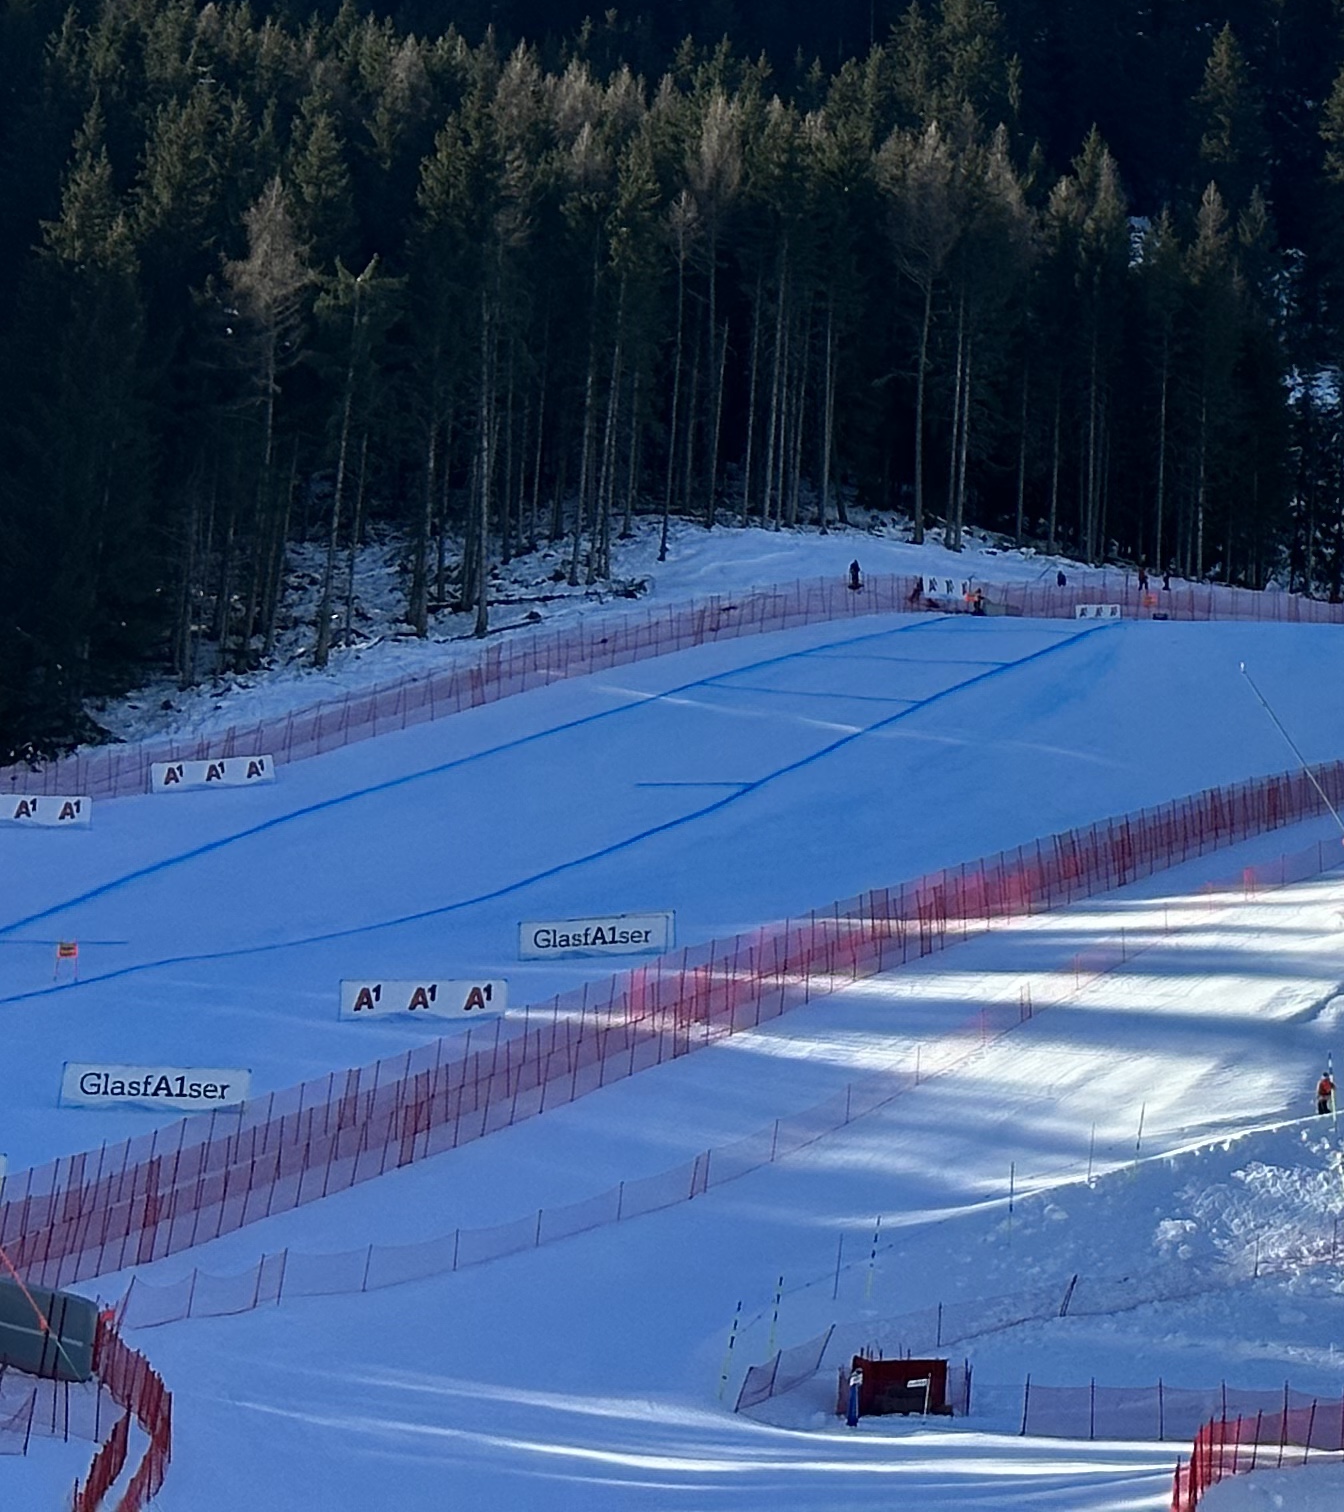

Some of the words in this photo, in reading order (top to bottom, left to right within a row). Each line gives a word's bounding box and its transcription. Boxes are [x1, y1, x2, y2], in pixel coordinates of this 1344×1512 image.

[164, 764, 184, 785] A1
[205, 761, 225, 782] A1
[246, 759, 265, 779] A1
[14, 798, 37, 819] A1
[58, 799, 81, 820] A1
[533, 926, 651, 949] GlasfA1ser
[353, 984, 382, 1011] A1
[408, 984, 437, 1010] A1
[463, 983, 492, 1010] A1
[80, 1072, 231, 1100] GlasfA1ser
